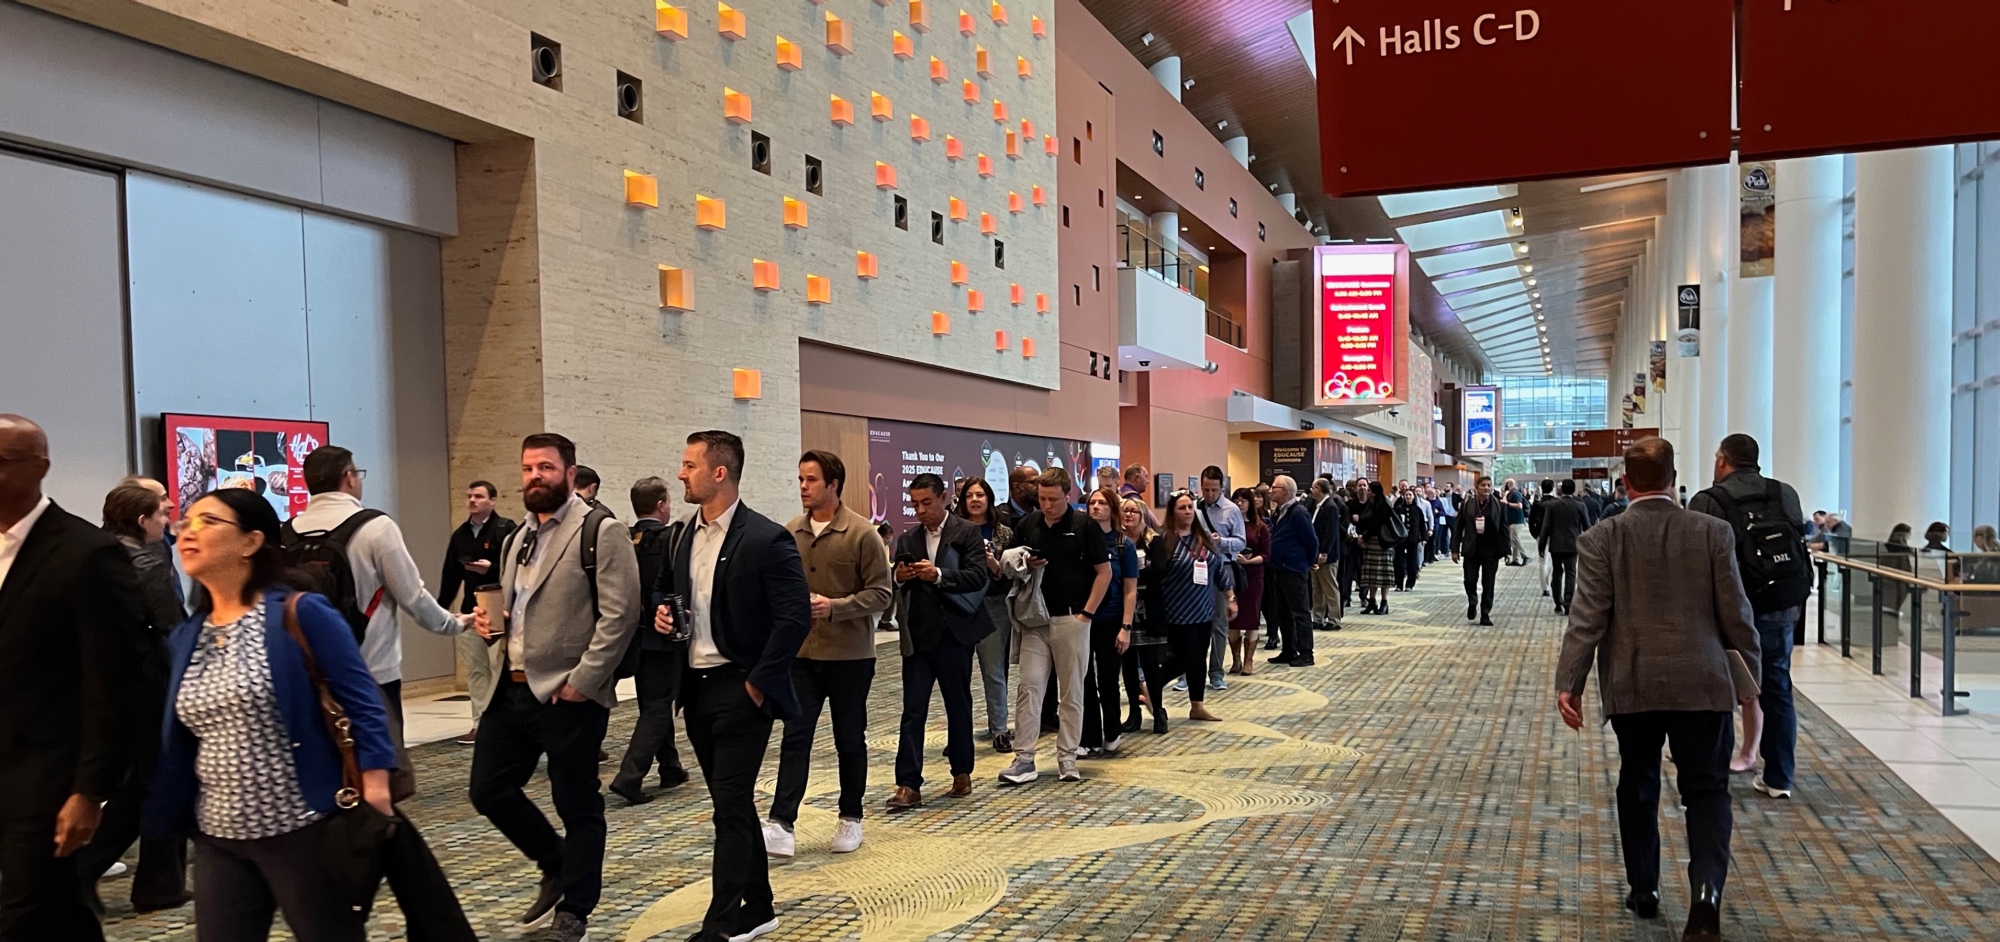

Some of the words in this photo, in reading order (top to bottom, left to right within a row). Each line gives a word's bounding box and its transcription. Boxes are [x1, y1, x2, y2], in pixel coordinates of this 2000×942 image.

[1379, 18, 1461, 56] Halls
[1473, 9, 1540, 46] C-D
[902, 451, 918, 461] Thank
[919, 452, 928, 462] You
[929, 452, 934, 462] to
[935, 453, 945, 462] Our
[902, 465, 915, 475] 2025
[916, 465, 943, 475] EDUCAUSE
